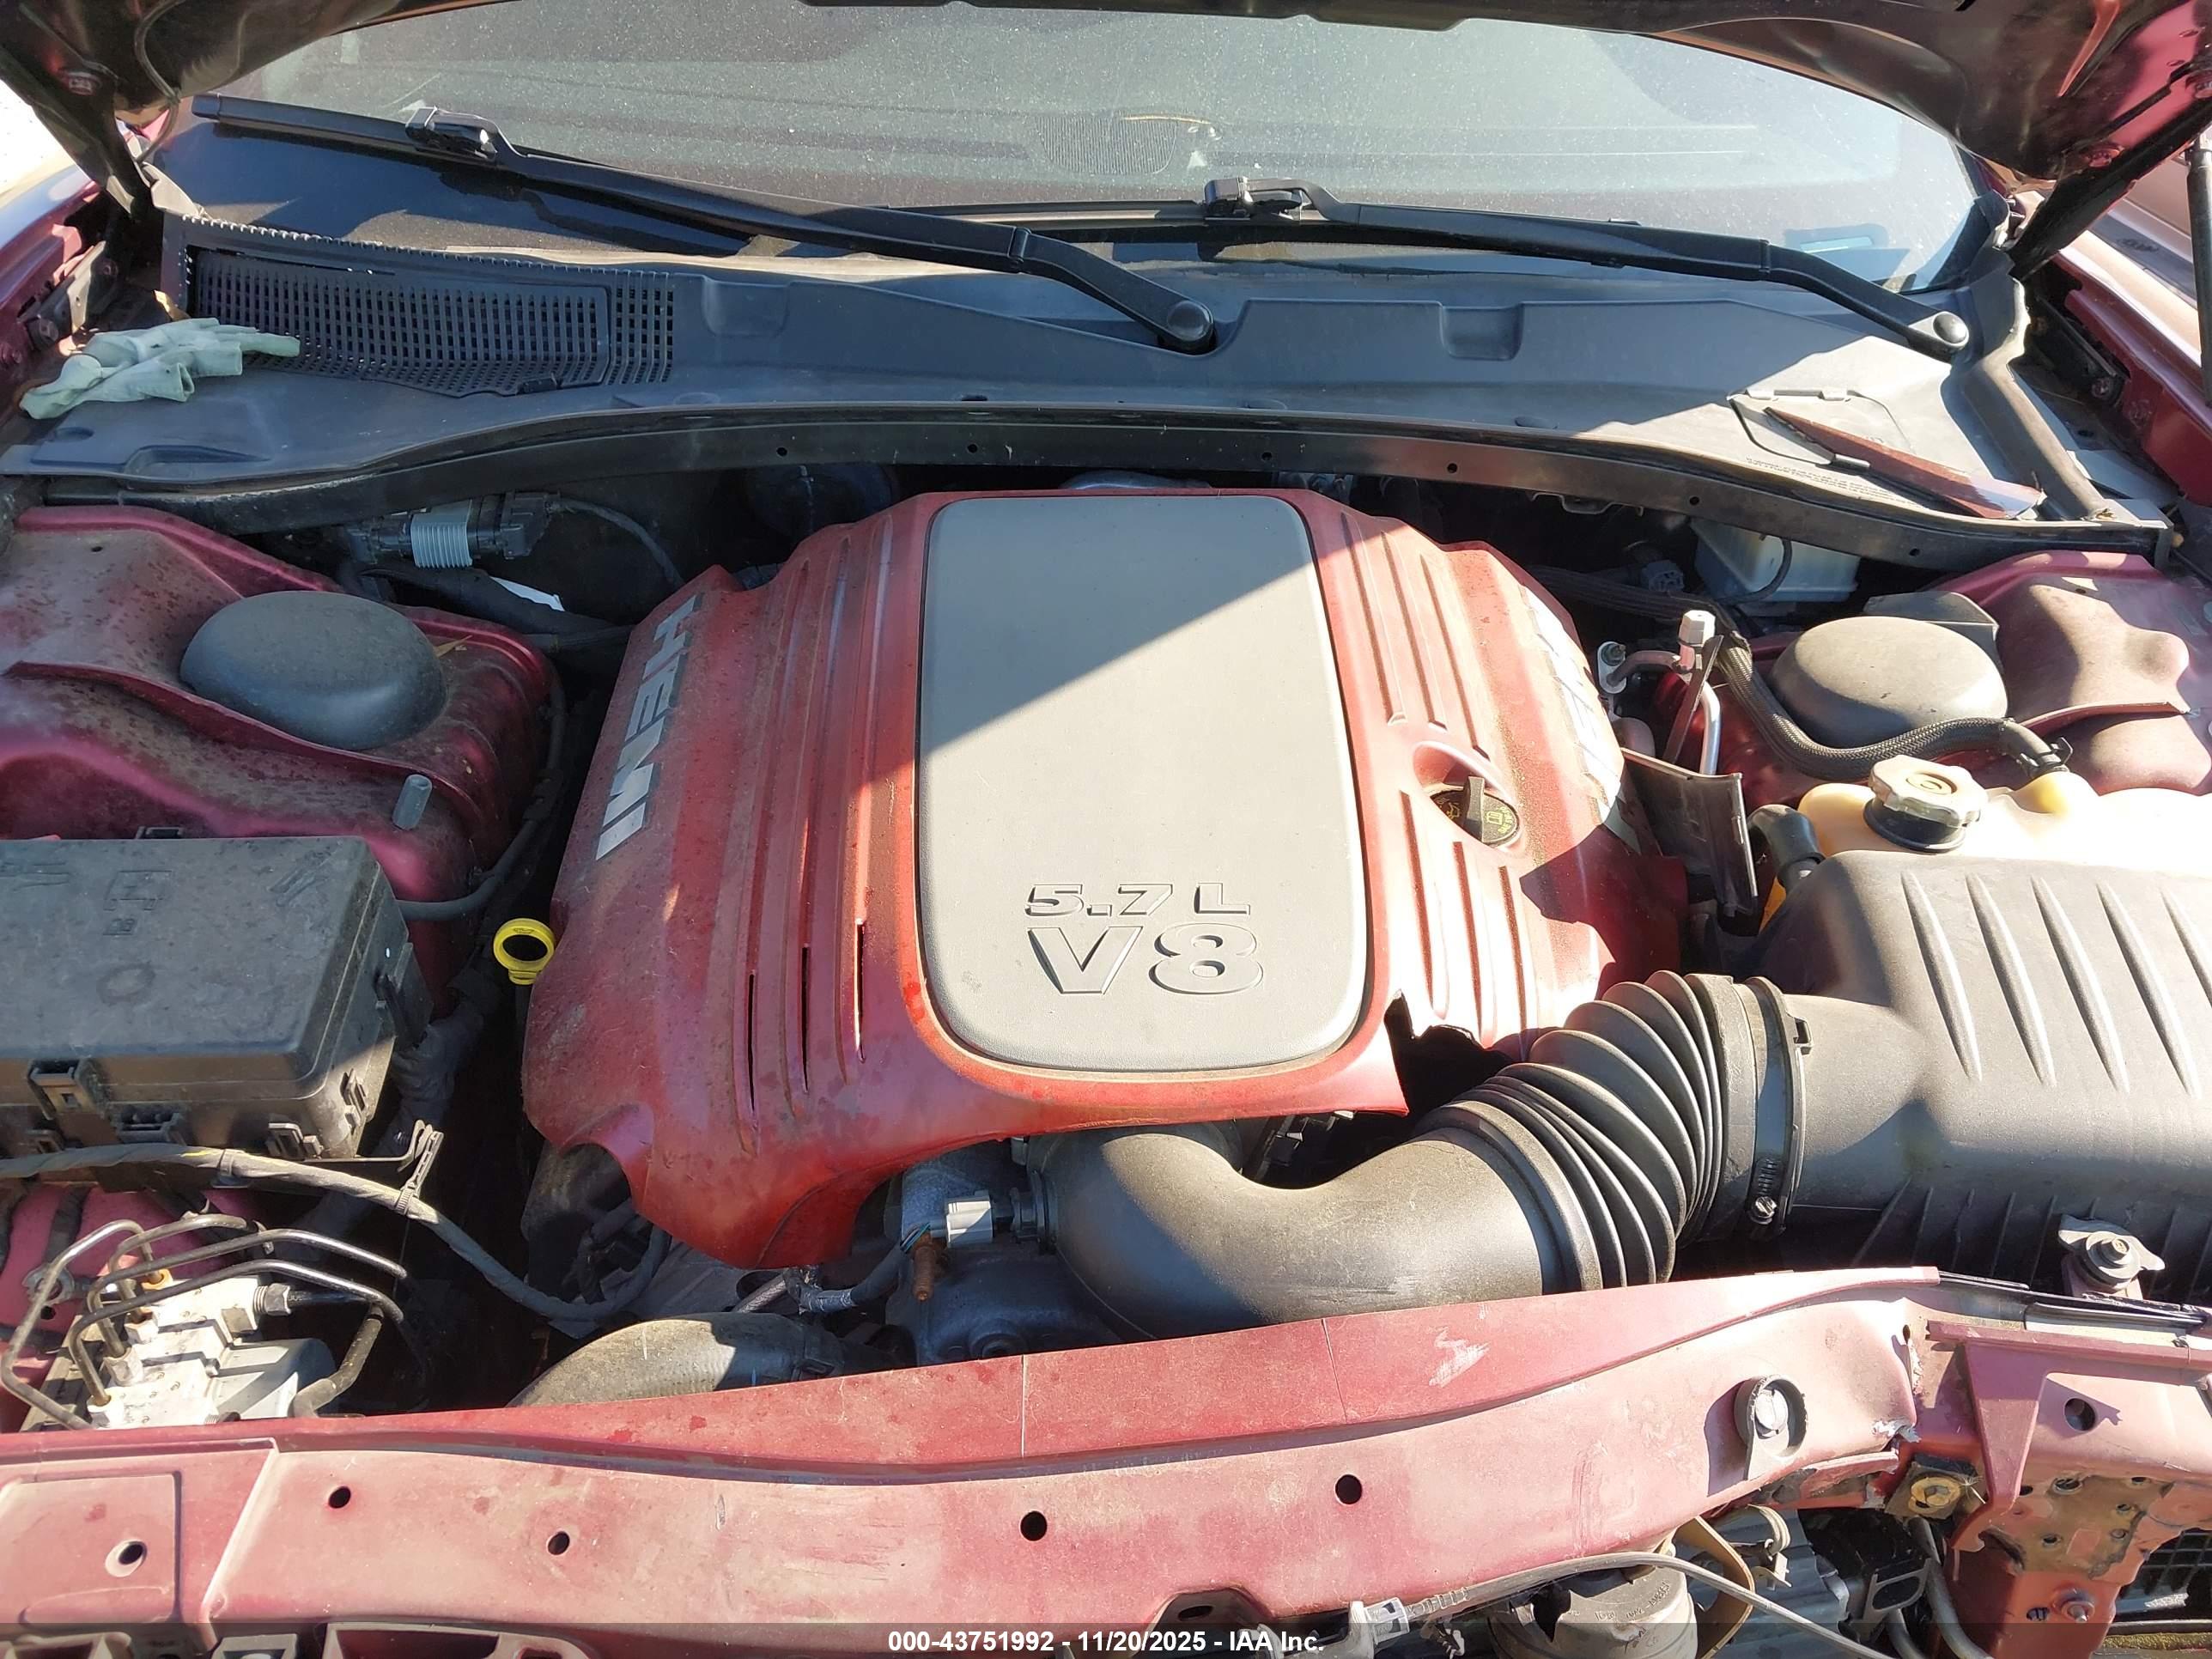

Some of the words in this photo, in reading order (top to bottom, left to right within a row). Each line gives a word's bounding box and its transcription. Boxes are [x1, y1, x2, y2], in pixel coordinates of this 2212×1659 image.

[596, 594, 697, 861] HEMI
[1025, 883, 1174, 917] 5.7
[1194, 882, 1251, 916] L
[1027, 922, 1264, 995] V8
